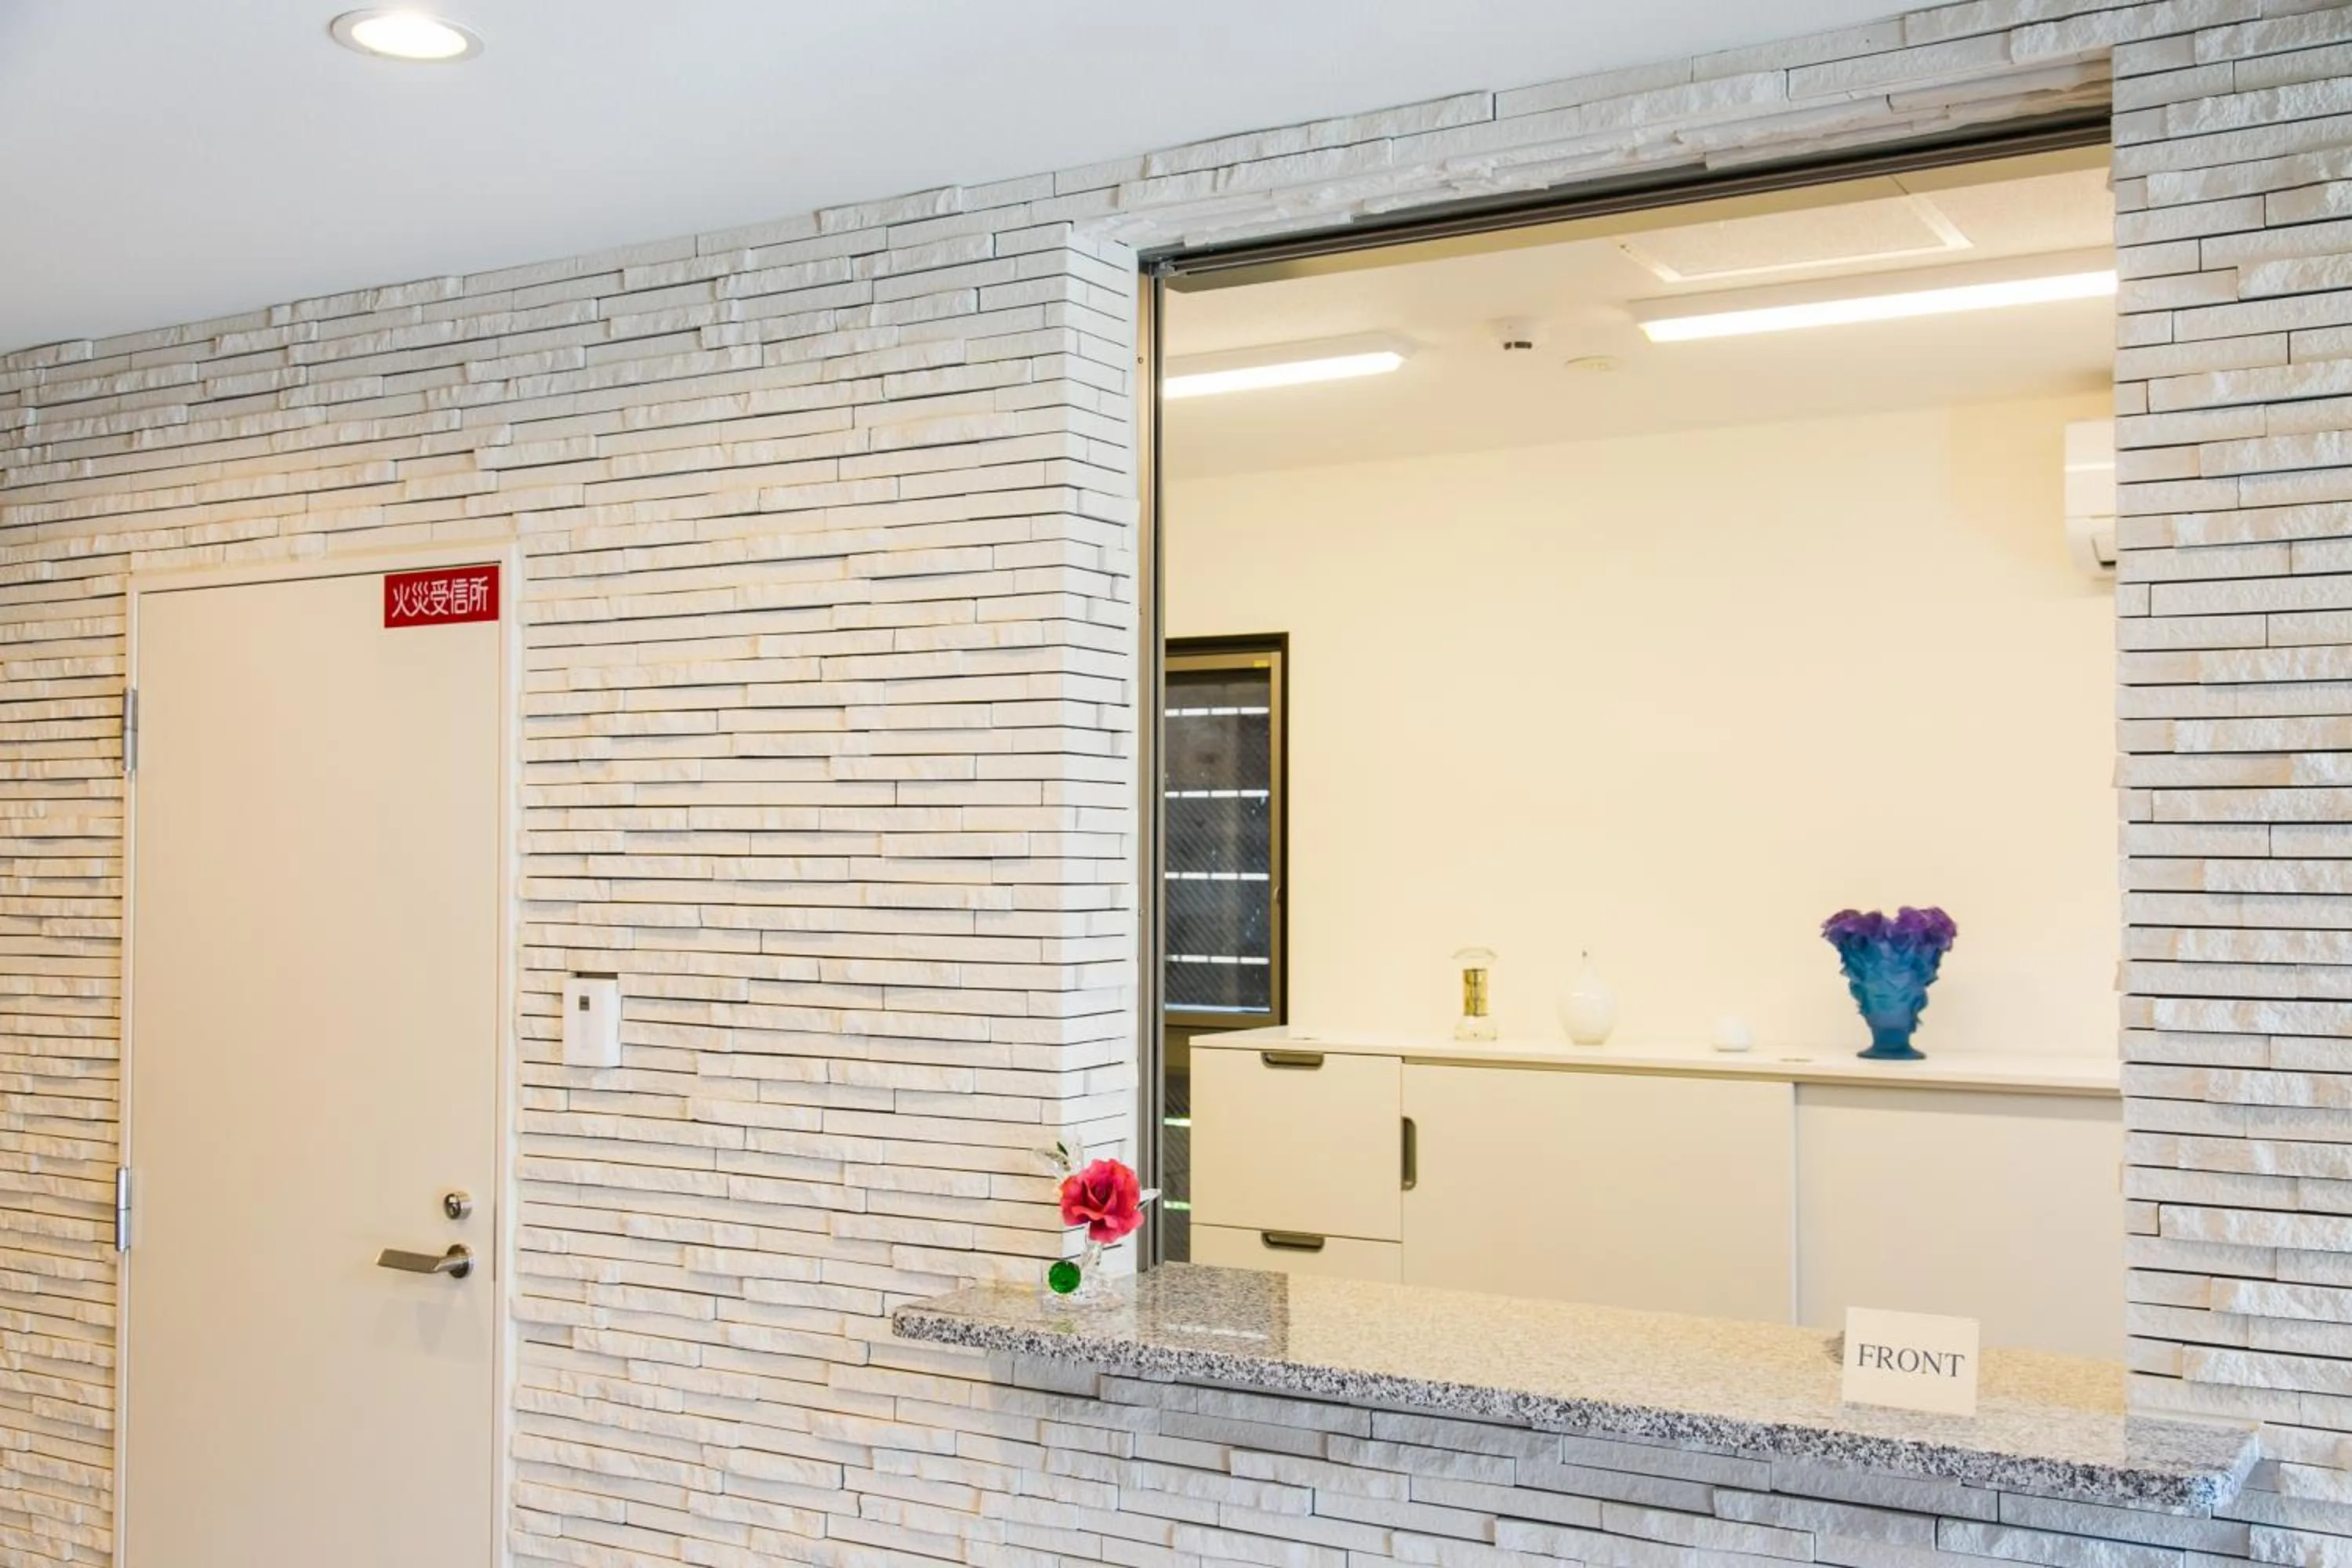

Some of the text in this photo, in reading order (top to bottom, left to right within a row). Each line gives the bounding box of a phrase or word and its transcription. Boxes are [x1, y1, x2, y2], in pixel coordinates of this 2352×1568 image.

[392, 576, 488, 617] 火災受信所
[1857, 1343, 1965, 1377] FRONT
